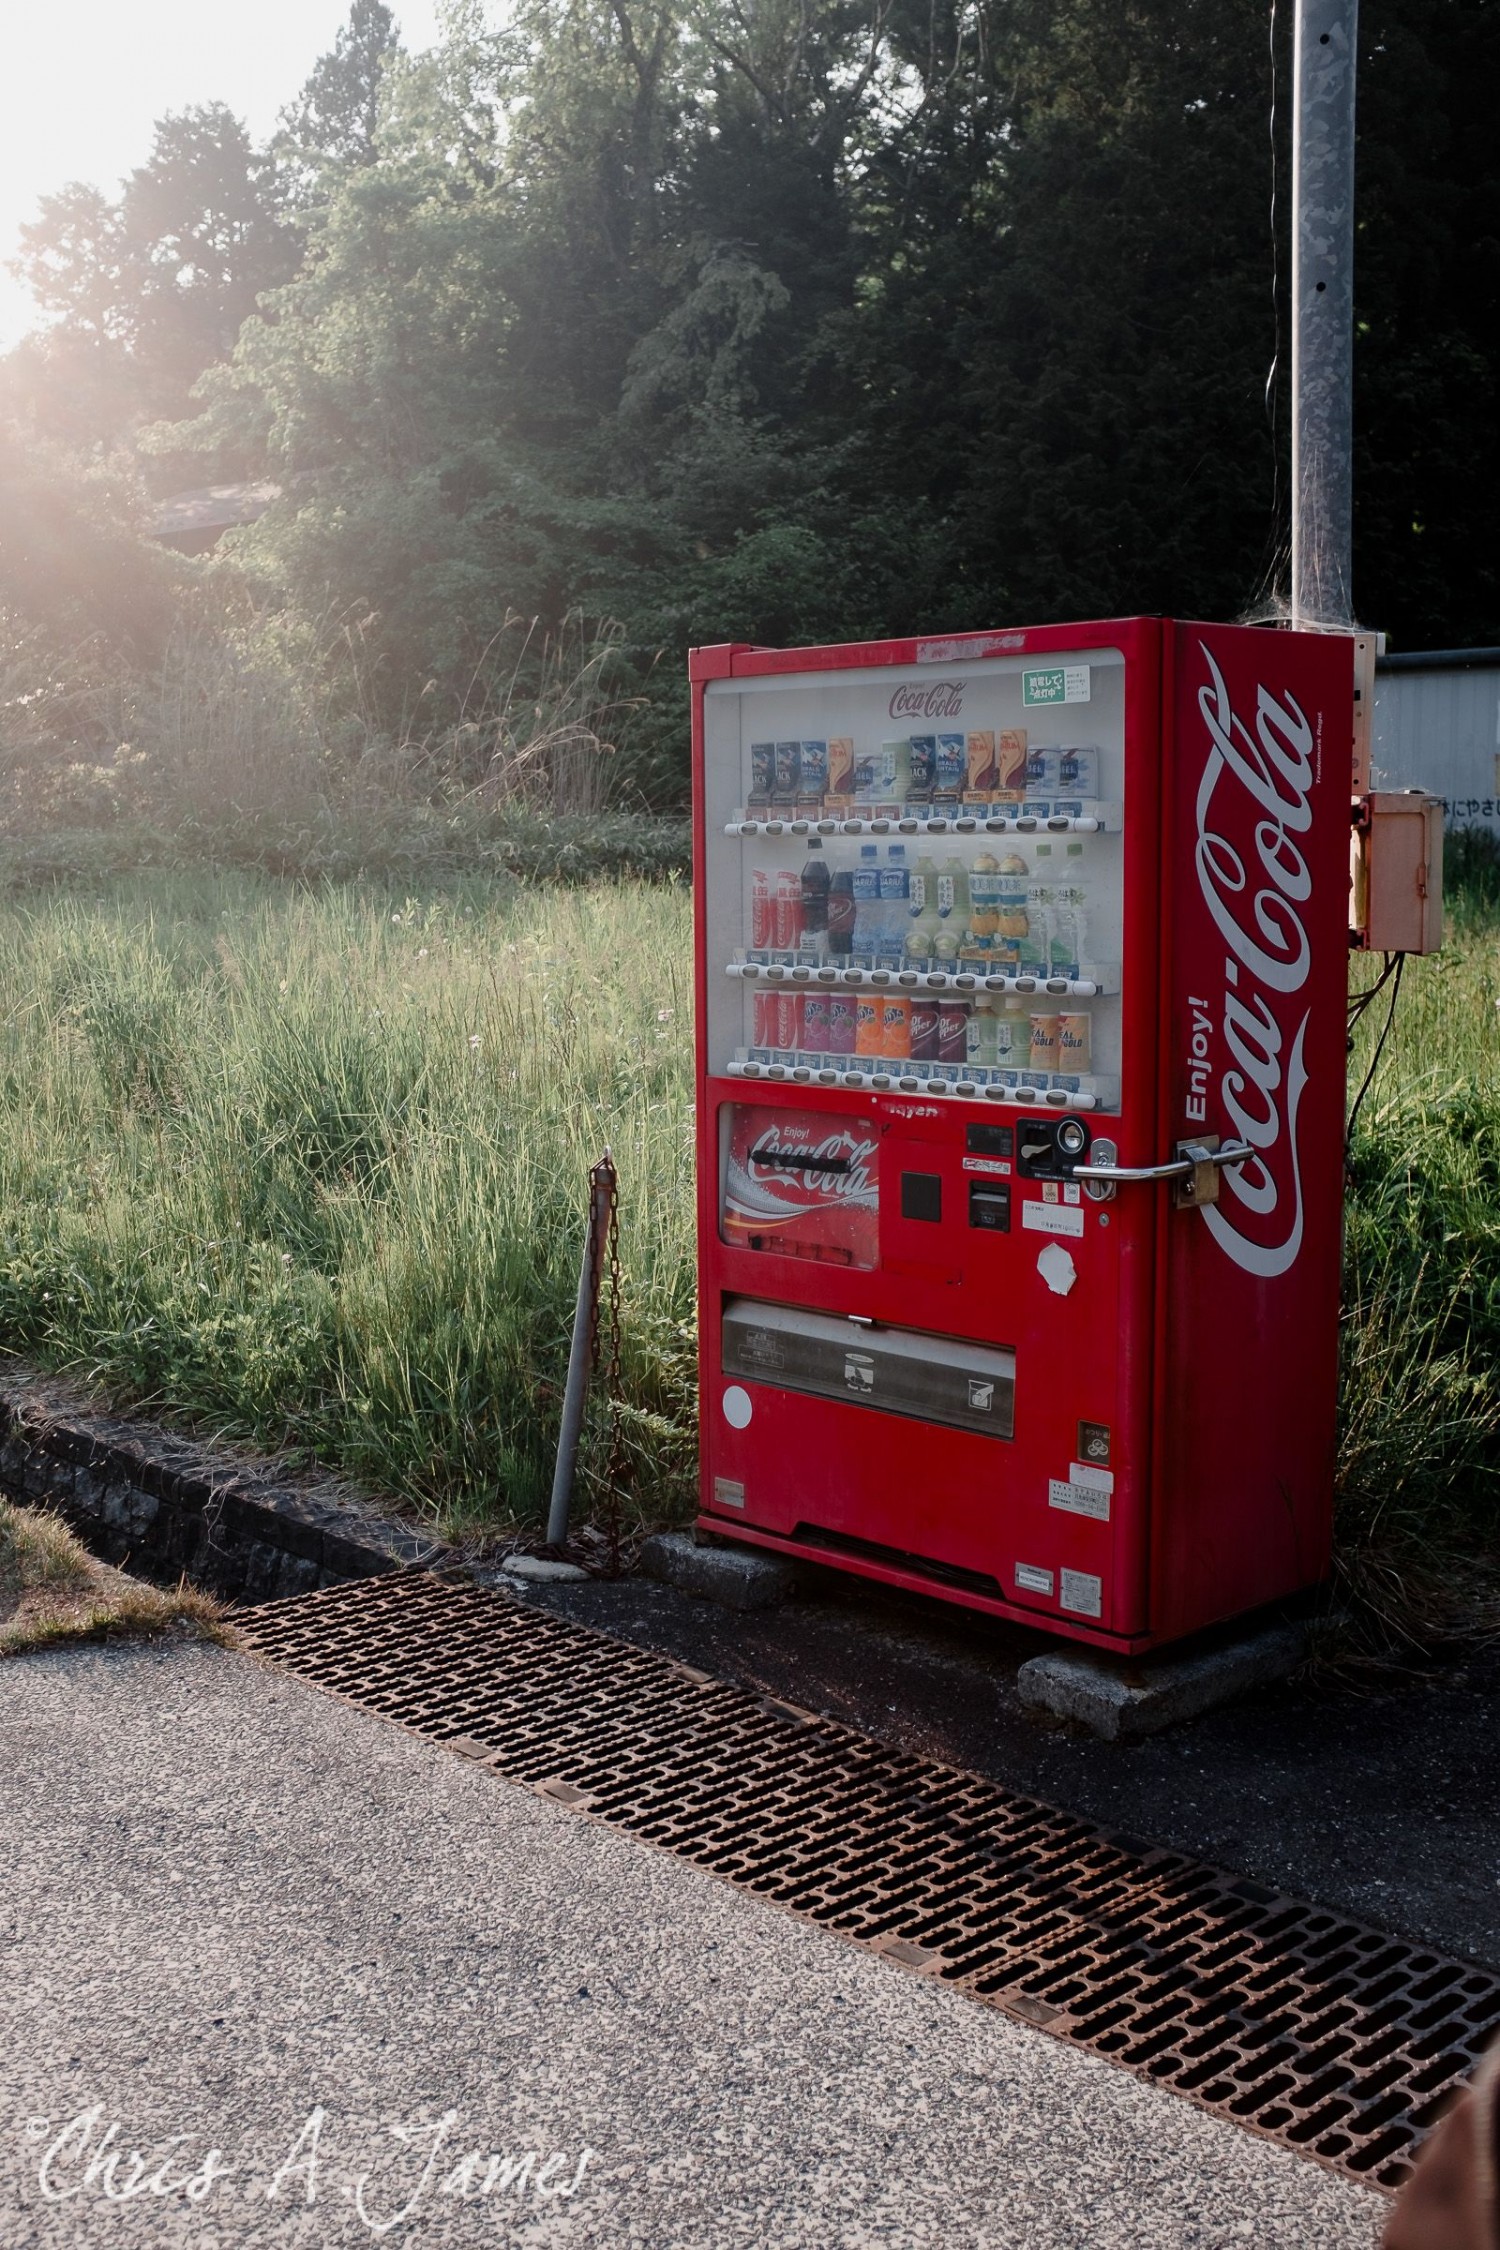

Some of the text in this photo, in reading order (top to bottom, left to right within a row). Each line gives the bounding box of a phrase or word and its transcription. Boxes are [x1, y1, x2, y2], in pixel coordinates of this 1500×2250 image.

[889, 682, 967, 719] Coca-Cola
[1195, 639, 1314, 1277] Coca-Cola
[1032, 1029, 1046, 1038] EAL
[1059, 1030, 1074, 1039] EAL
[1186, 996, 1212, 1121] Enjoy!
[783, 1126, 810, 1140] Enjoy!
[747, 1124, 879, 1194] Coca-Cola
